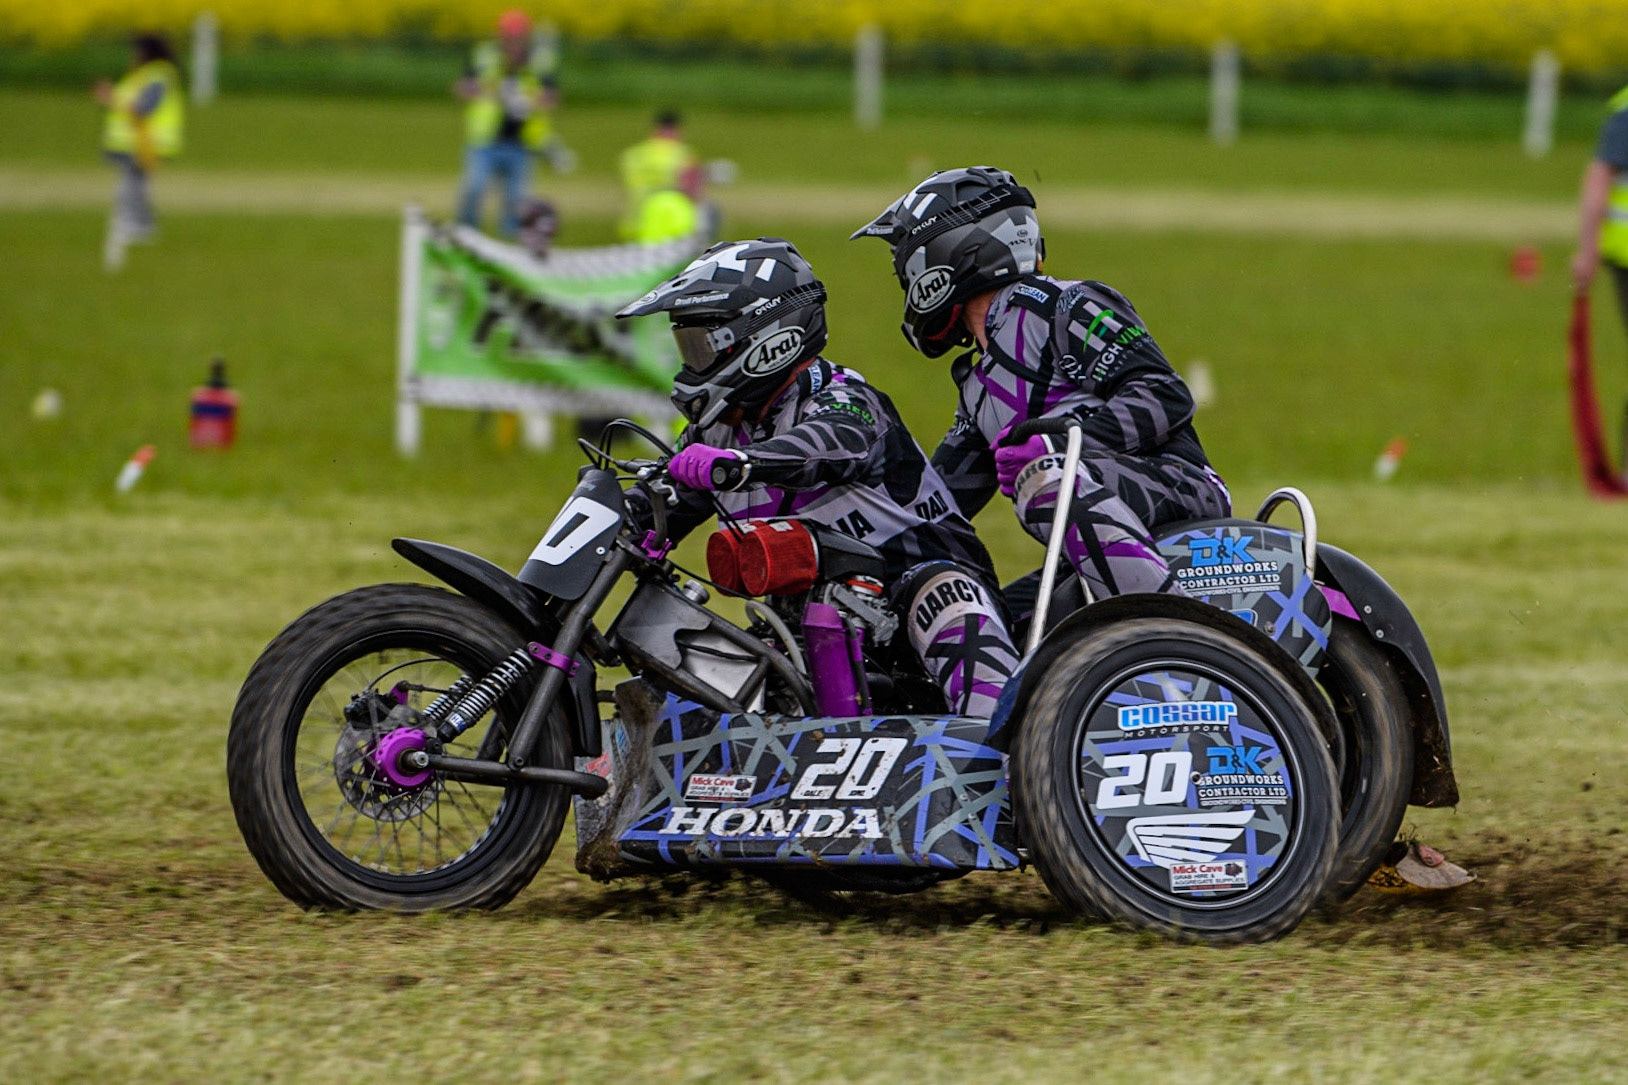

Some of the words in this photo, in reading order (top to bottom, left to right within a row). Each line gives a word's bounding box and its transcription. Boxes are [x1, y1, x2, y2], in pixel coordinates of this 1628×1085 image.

[912, 269, 949, 309] Arai
[755, 295, 780, 316] OAKLEY
[745, 330, 798, 373] Arai
[1188, 536, 1256, 567] D&K
[1177, 562, 1278, 578] GROUNDWORKS
[1180, 575, 1256, 589] CONTRACTOR
[1259, 574, 1280, 583] LTD
[916, 579, 984, 632] DARCY
[1125, 725, 1229, 738] MOTORSPORT
[790, 738, 908, 800] 20
[1206, 746, 1264, 775] D&K
[692, 777, 712, 785] Mick
[714, 778, 734, 786] Cave
[1096, 752, 1193, 810] 20
[1199, 788, 1266, 797] CONTRACTOR
[1268, 787, 1287, 796] LTD
[658, 806, 884, 838] HONDA
[1173, 865, 1197, 874] Mick
[1199, 864, 1223, 873] Cave
